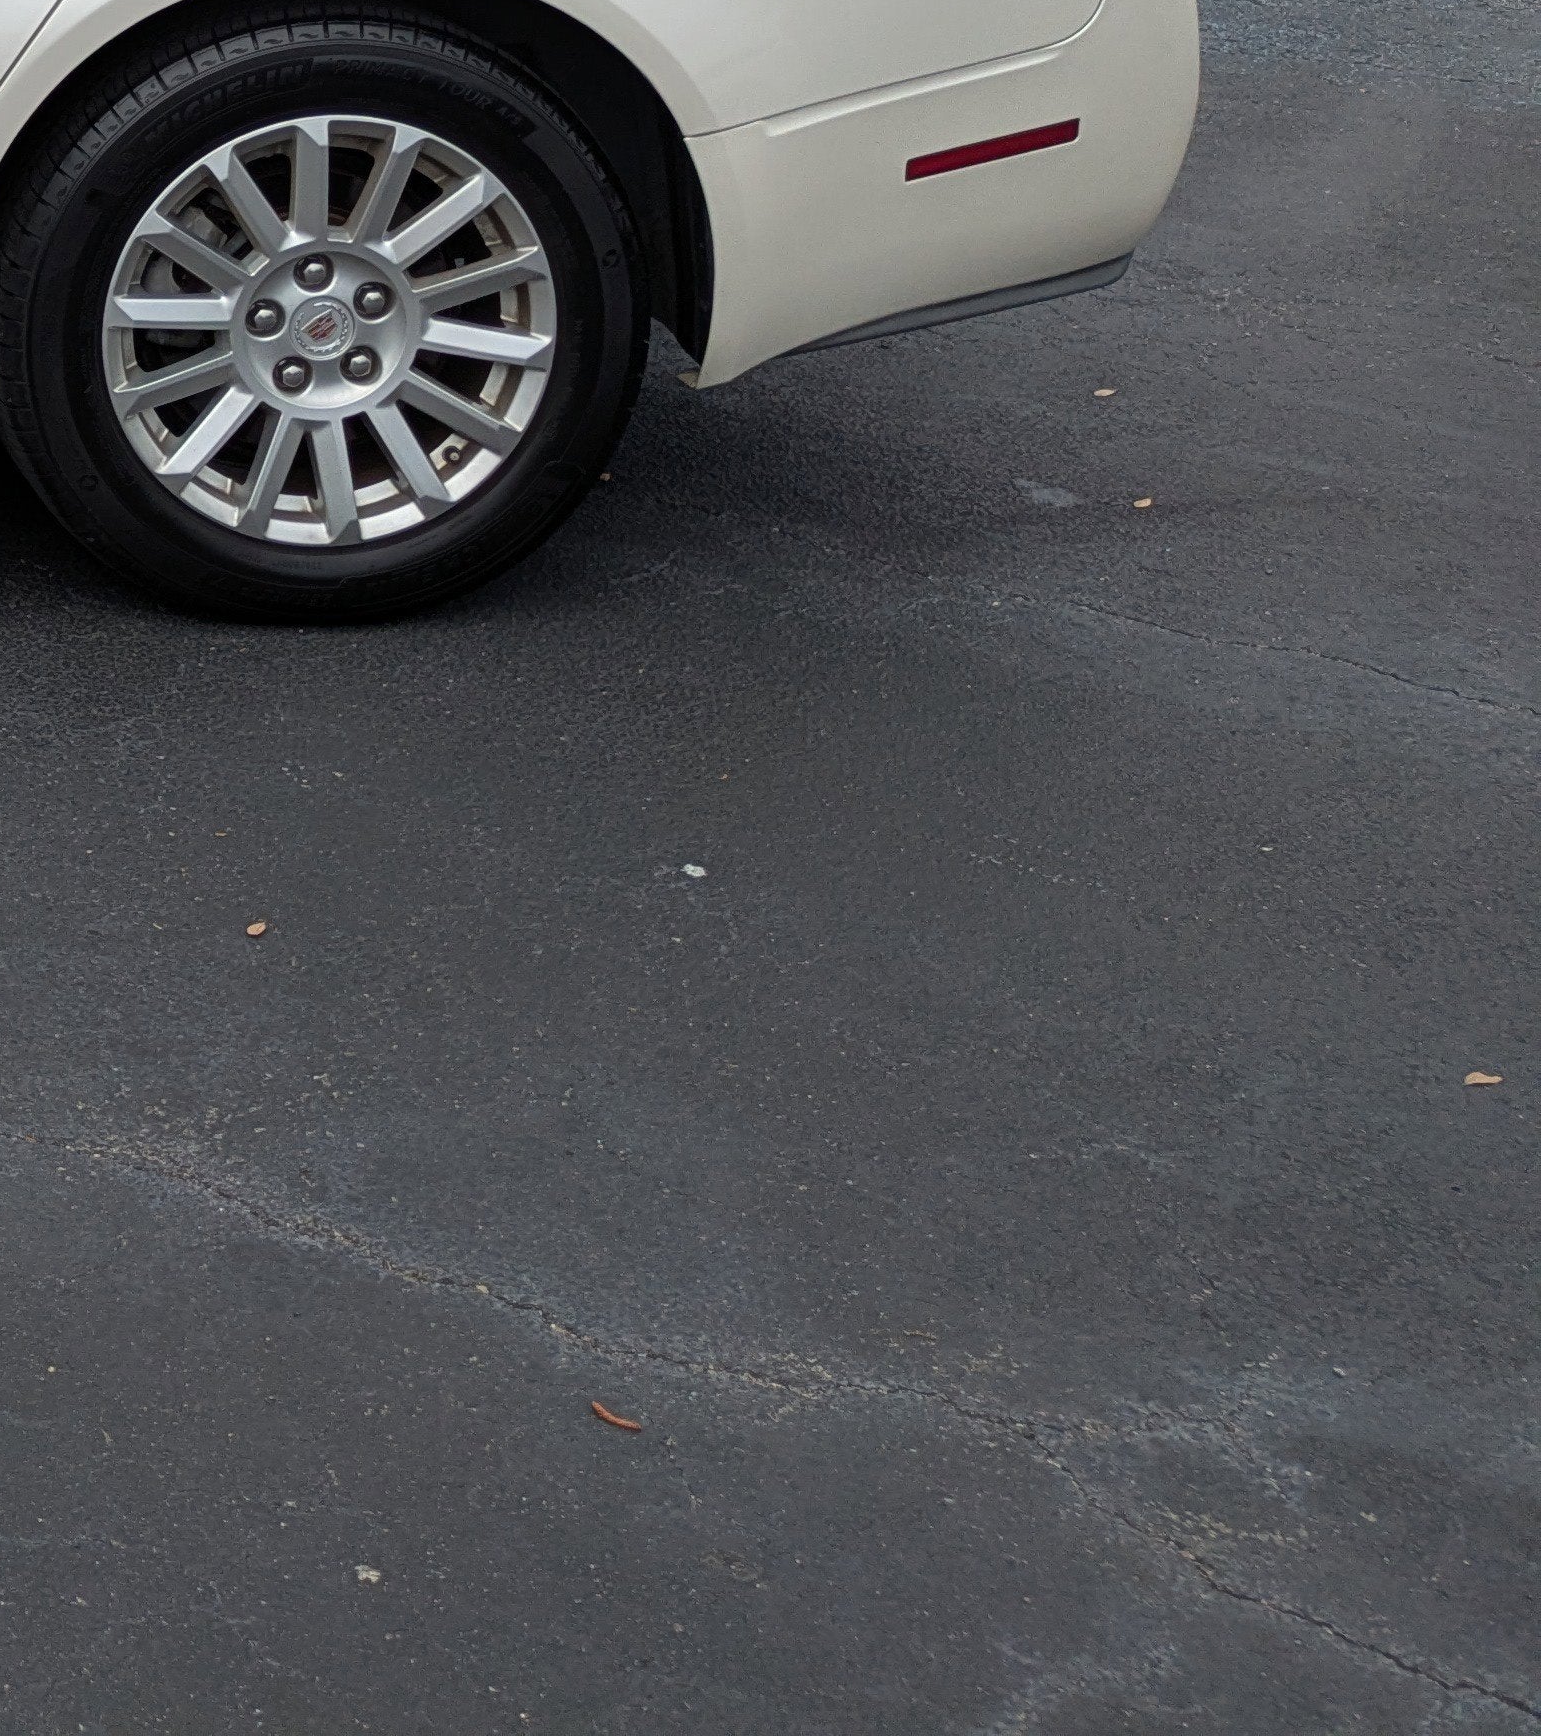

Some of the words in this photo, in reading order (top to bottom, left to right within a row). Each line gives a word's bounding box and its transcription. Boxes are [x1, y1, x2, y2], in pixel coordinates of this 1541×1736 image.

[144, 64, 304, 145] MICHELIN
[334, 58, 430, 83] PRIMACY
[438, 79, 492, 110] TOUR
